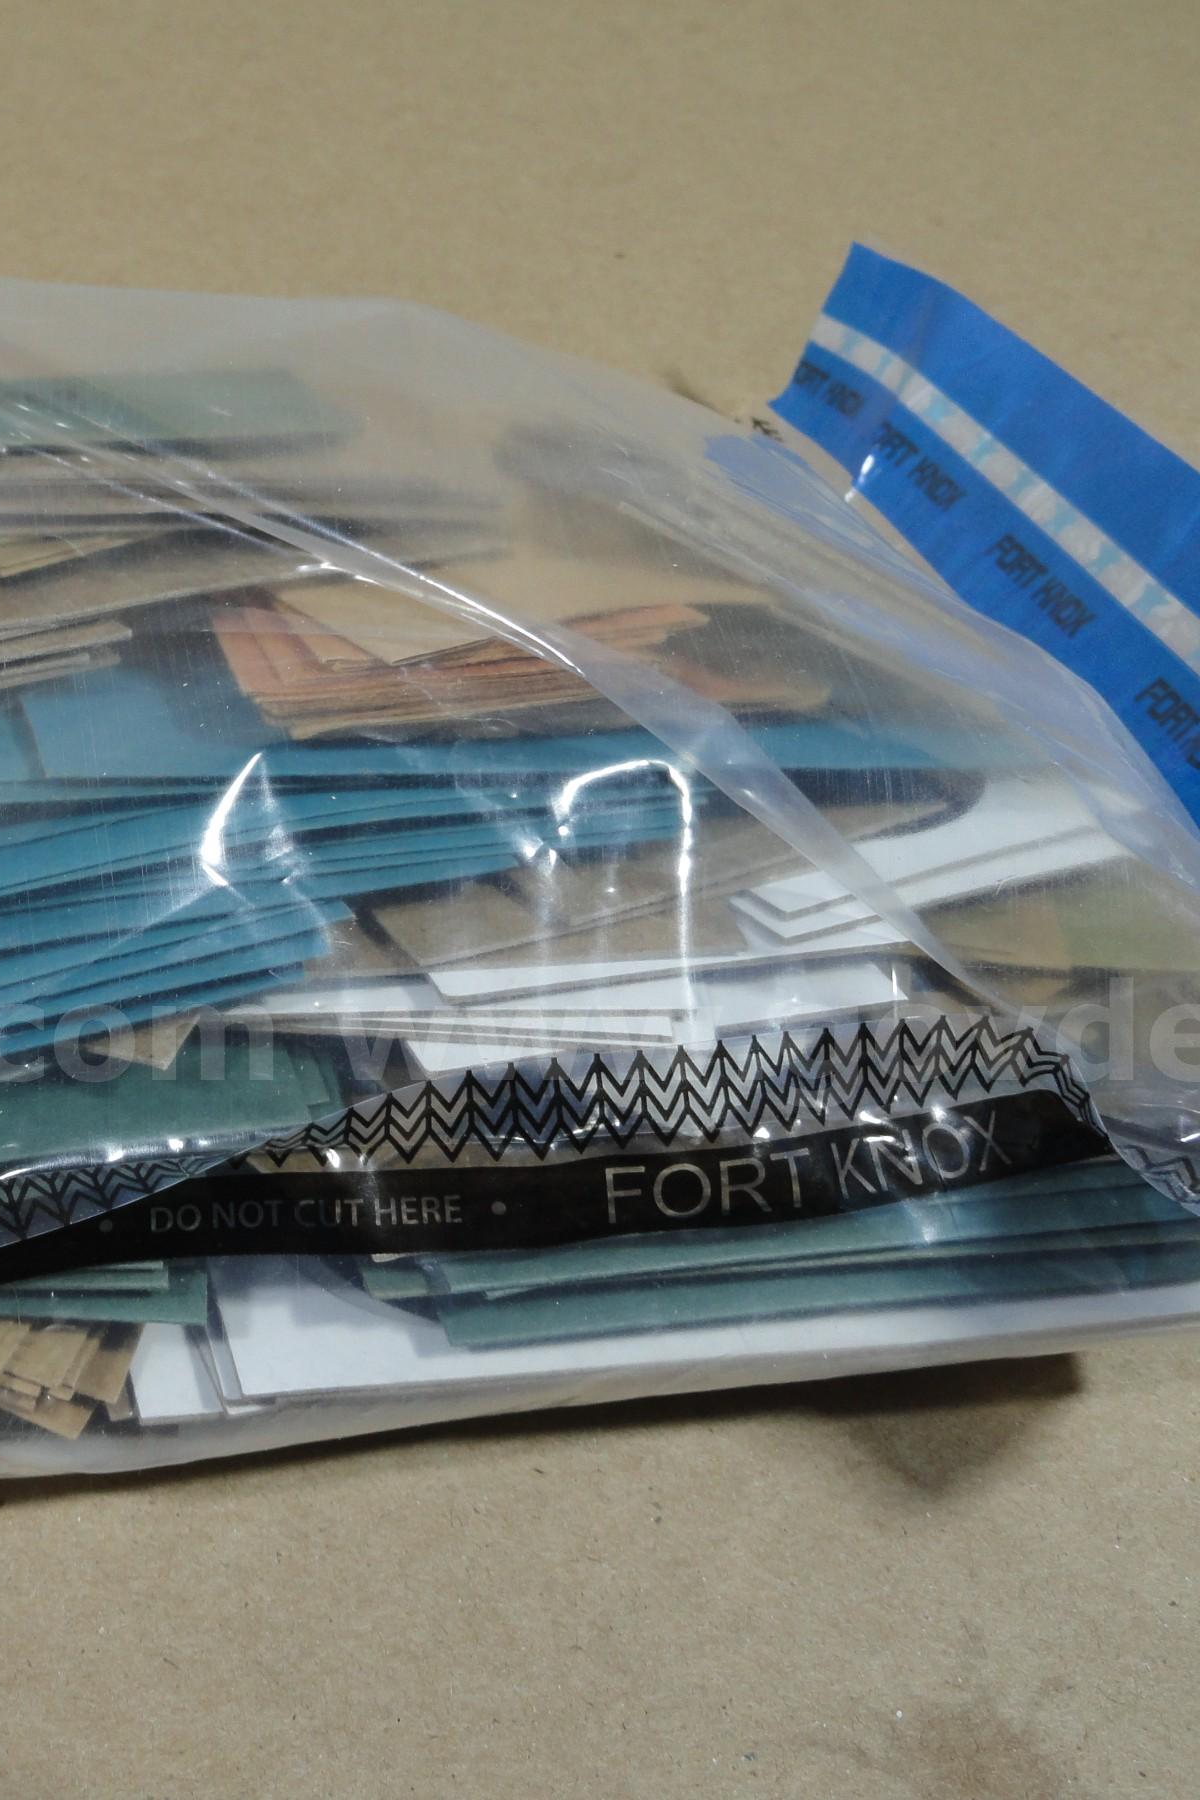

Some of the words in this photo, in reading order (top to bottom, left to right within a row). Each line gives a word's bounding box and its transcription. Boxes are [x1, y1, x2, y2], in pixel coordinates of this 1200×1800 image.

[984, 533, 1048, 589] FORT
[1030, 577, 1096, 639] KNOX
[150, 1203, 202, 1233] DO
[212, 1202, 281, 1231] NOT
[293, 1198, 364, 1227] CUT
[373, 1195, 464, 1226] HERE
[605, 1148, 810, 1225] FORT
[830, 1110, 1012, 1200] KNOX
